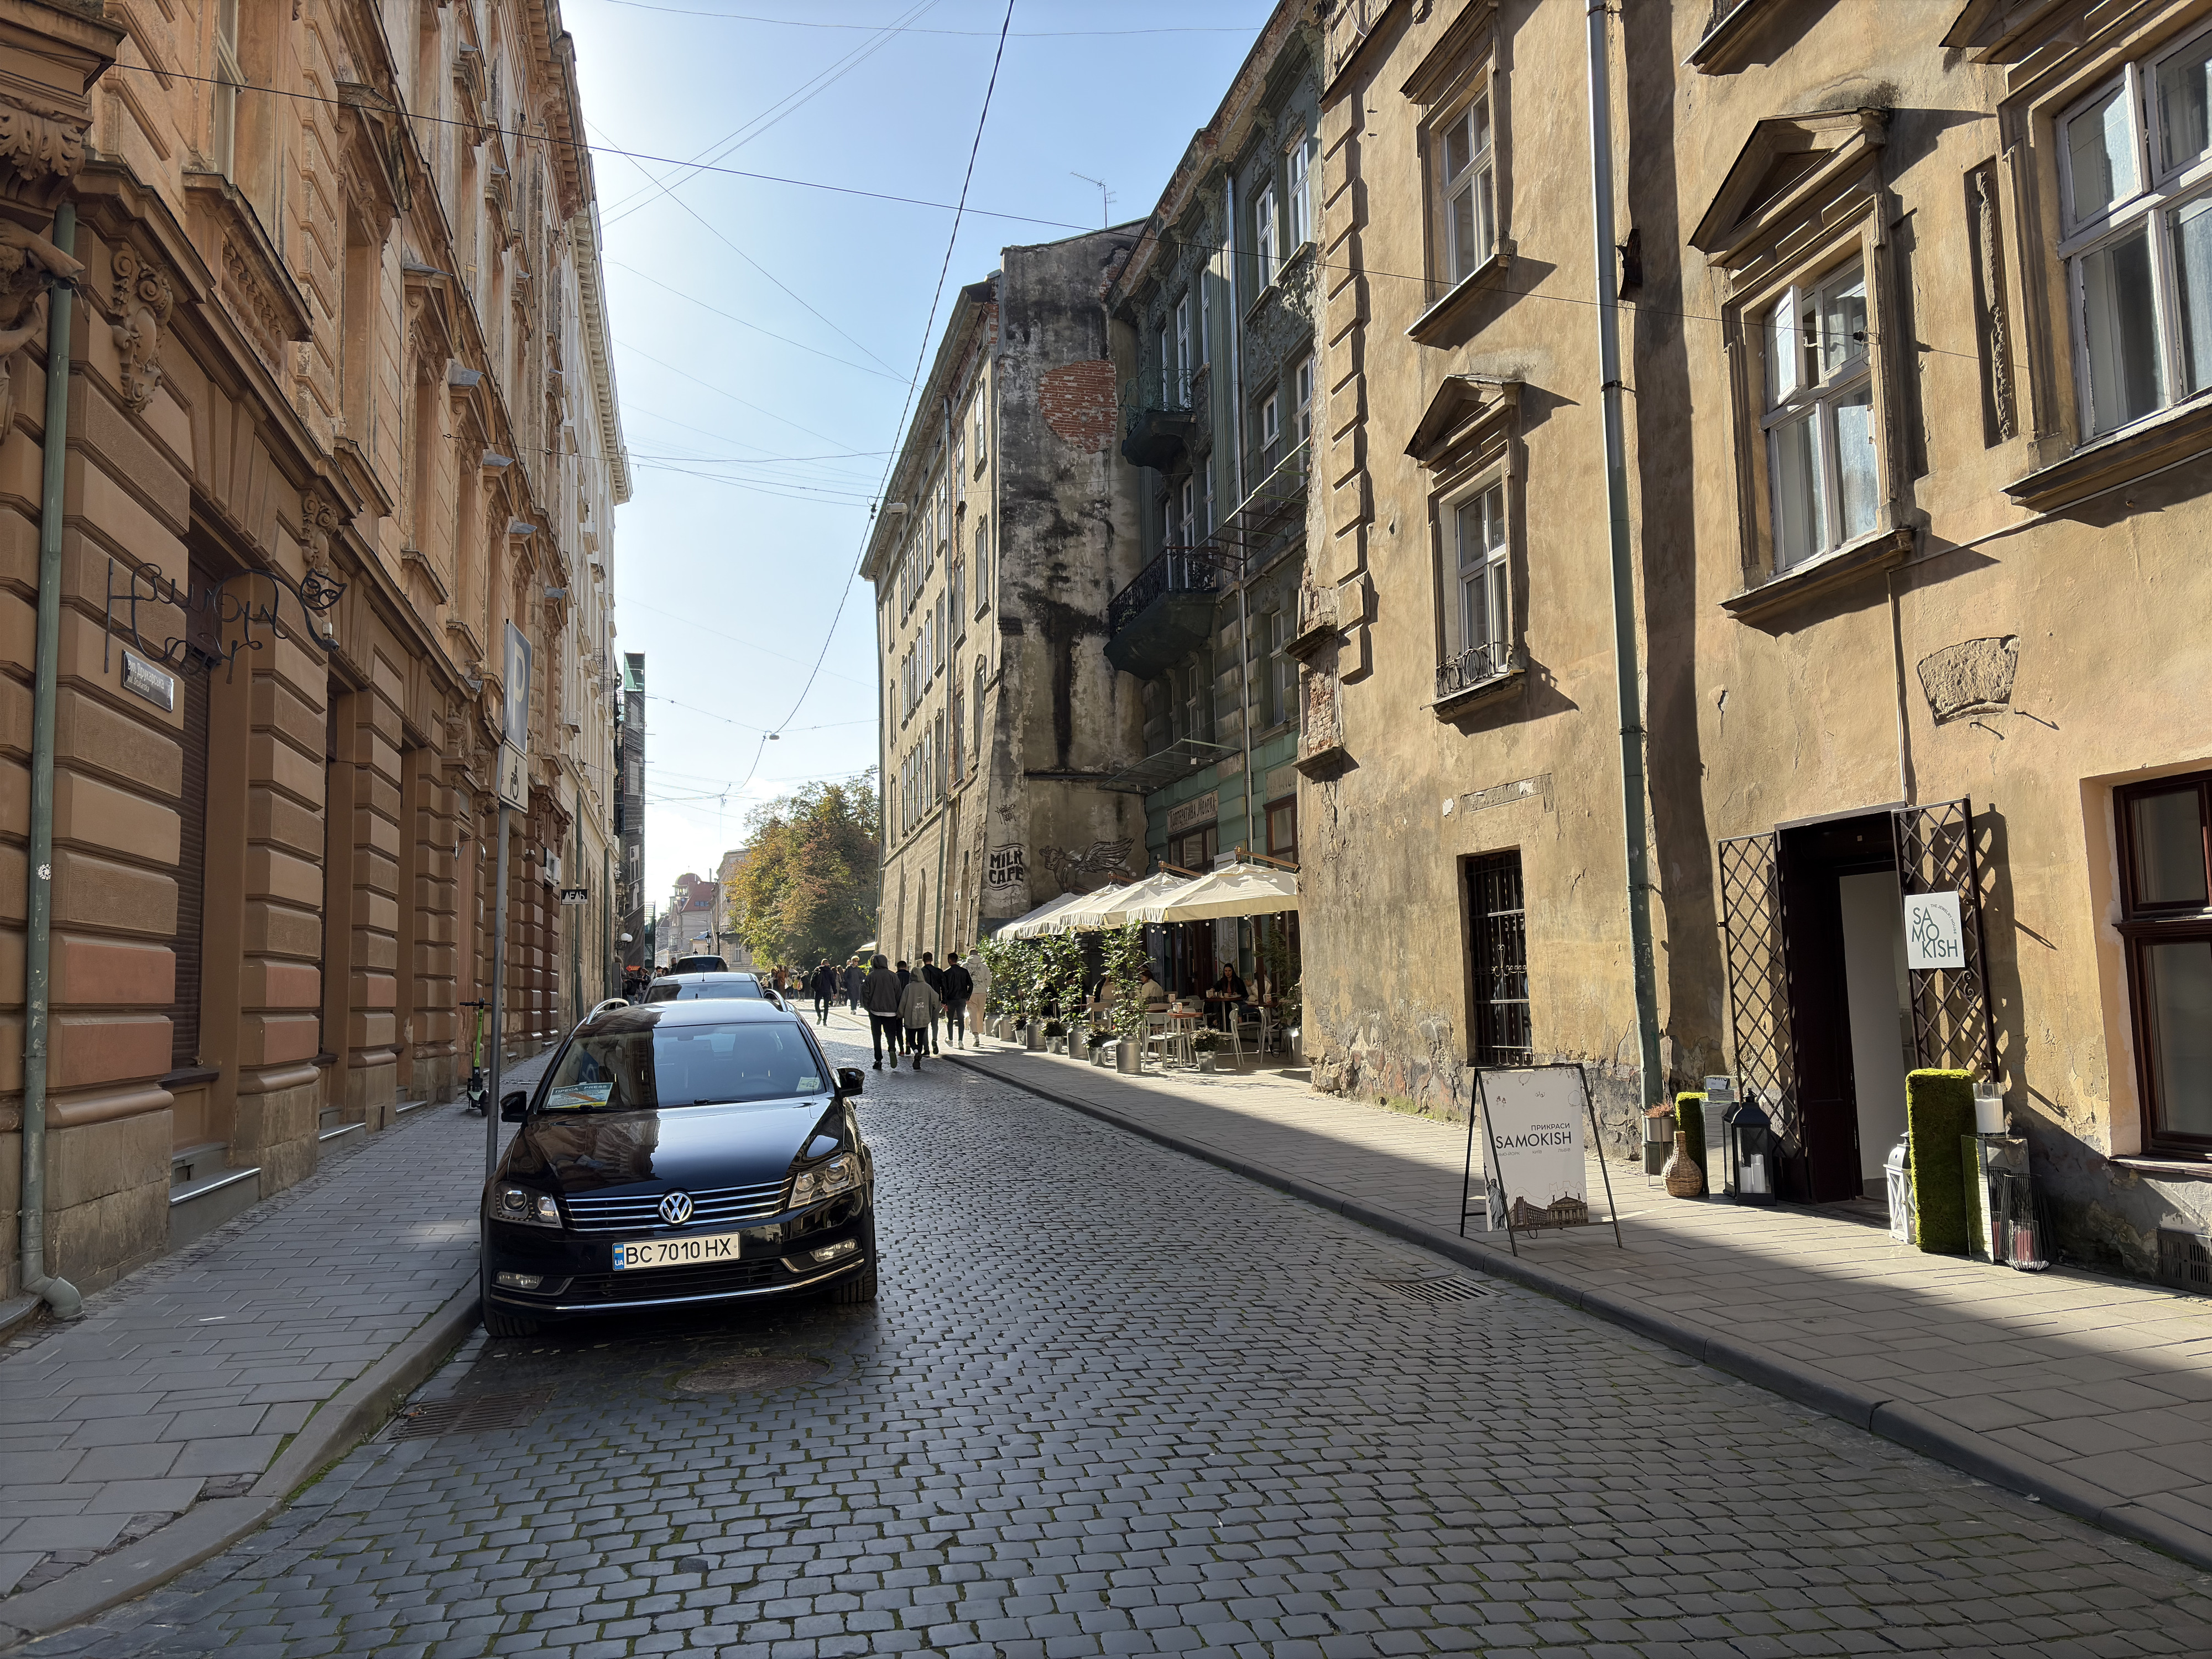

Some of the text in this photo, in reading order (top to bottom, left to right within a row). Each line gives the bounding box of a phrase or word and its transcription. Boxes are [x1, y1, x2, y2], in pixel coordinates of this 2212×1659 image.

[990, 849, 1023, 869] MILK
[989, 865, 1024, 885] CAFE
[1938, 905, 1952, 918] JEWELRY
[1922, 939, 1958, 958] KISH
[1531, 1123, 1570, 1131] ПРИКРАСИ
[1495, 1131, 1572, 1149] SAMOKISH
[626, 1238, 731, 1265] BC 7010 HX
